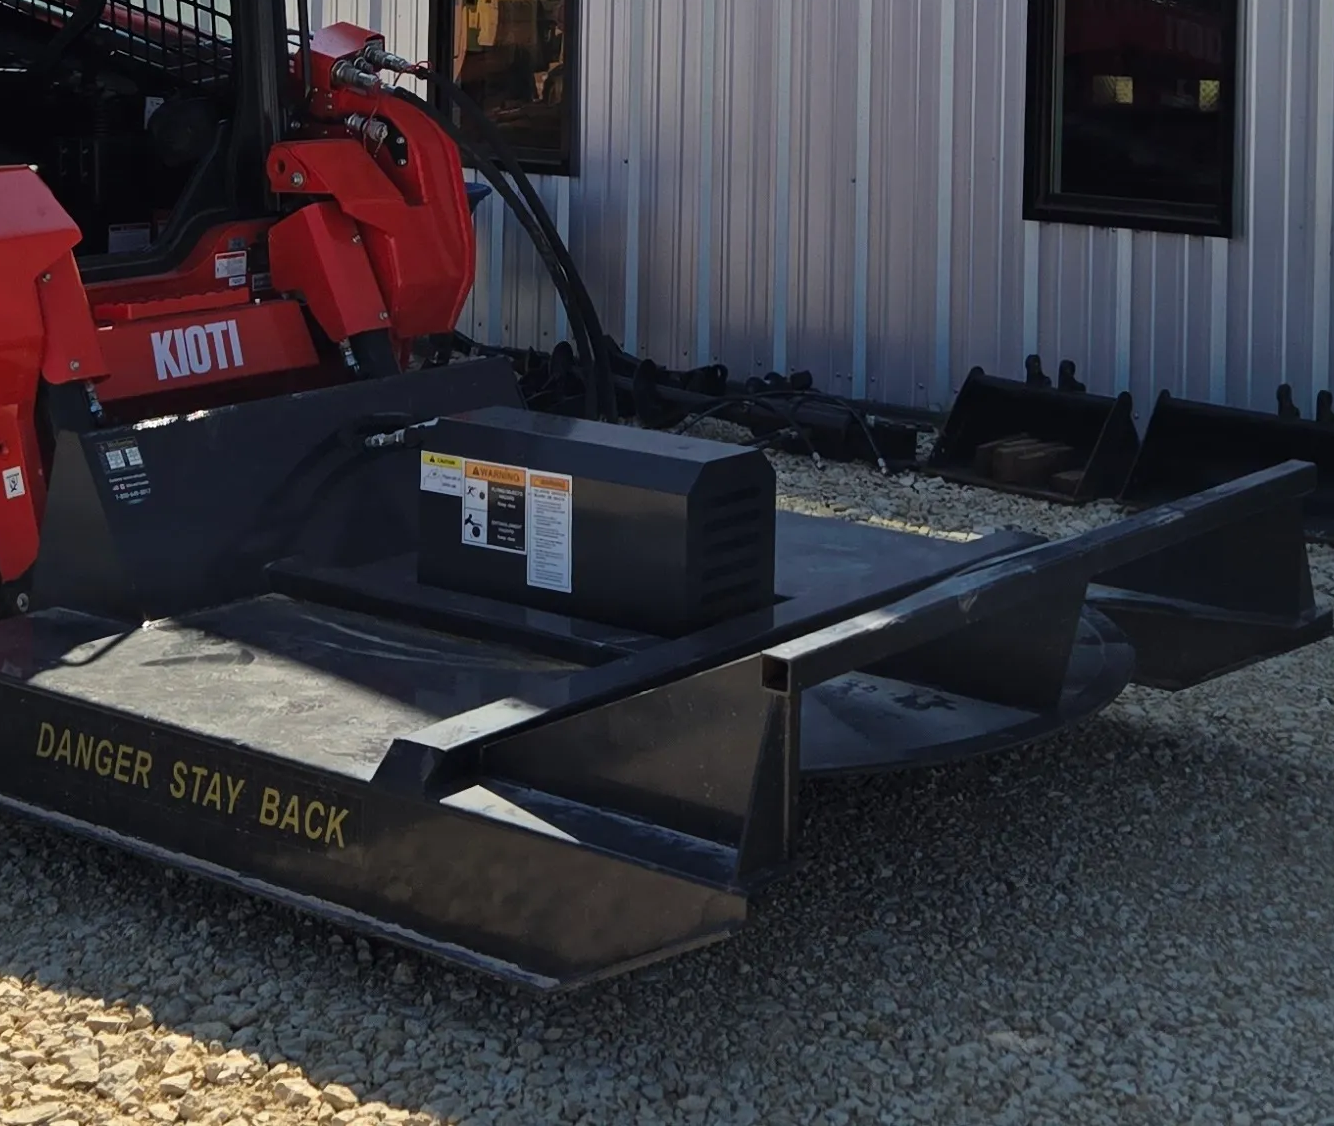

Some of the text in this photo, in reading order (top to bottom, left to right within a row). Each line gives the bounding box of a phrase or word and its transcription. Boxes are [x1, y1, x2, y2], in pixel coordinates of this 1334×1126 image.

[150, 319, 244, 381] KIOTI
[480, 468, 520, 483] WARNING
[36, 722, 349, 848] DANGER STAY BACK
